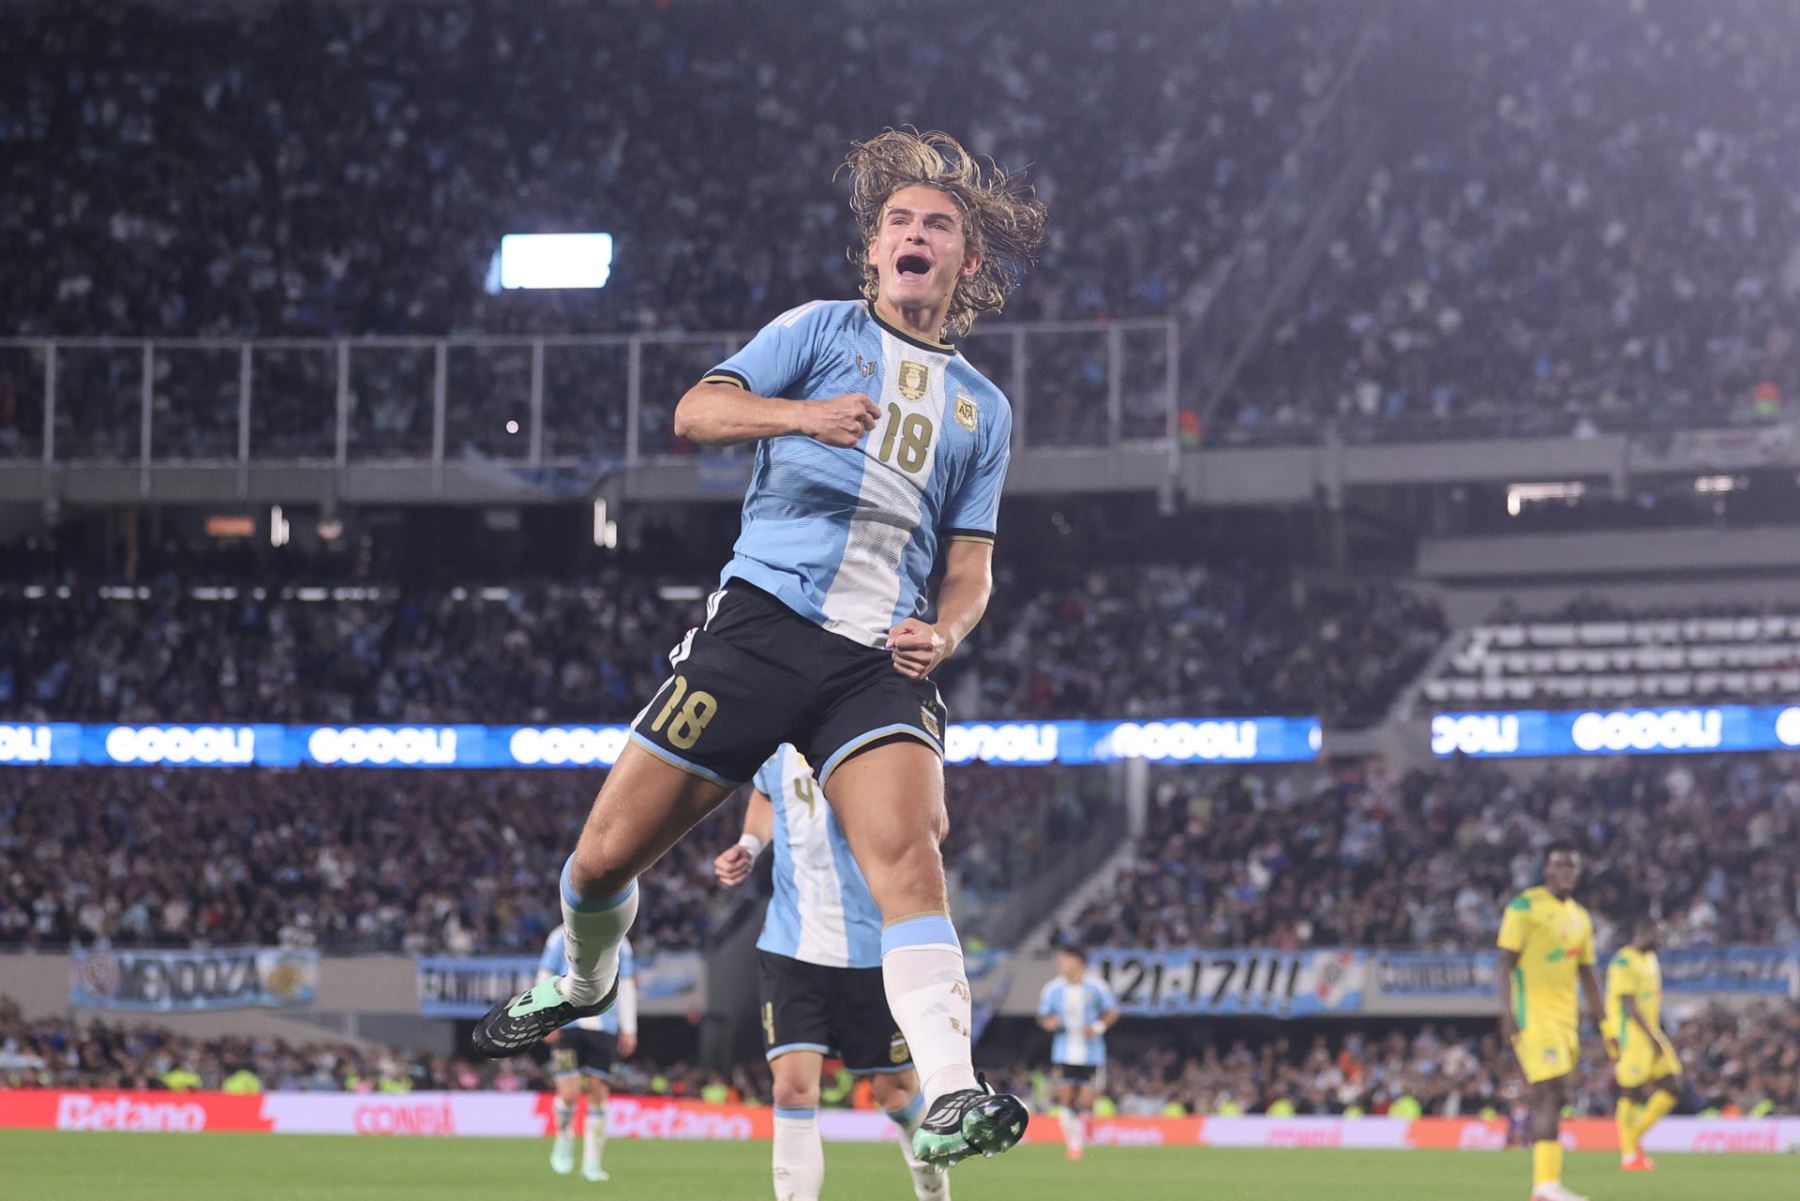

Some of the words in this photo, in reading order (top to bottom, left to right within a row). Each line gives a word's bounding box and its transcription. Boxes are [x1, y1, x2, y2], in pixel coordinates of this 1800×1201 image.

[878, 402, 933, 474] 18
[651, 675, 717, 749] 18
[794, 778, 815, 819] 4
[761, 1002, 775, 1045] 4
[57, 1093, 208, 1132] Betano
